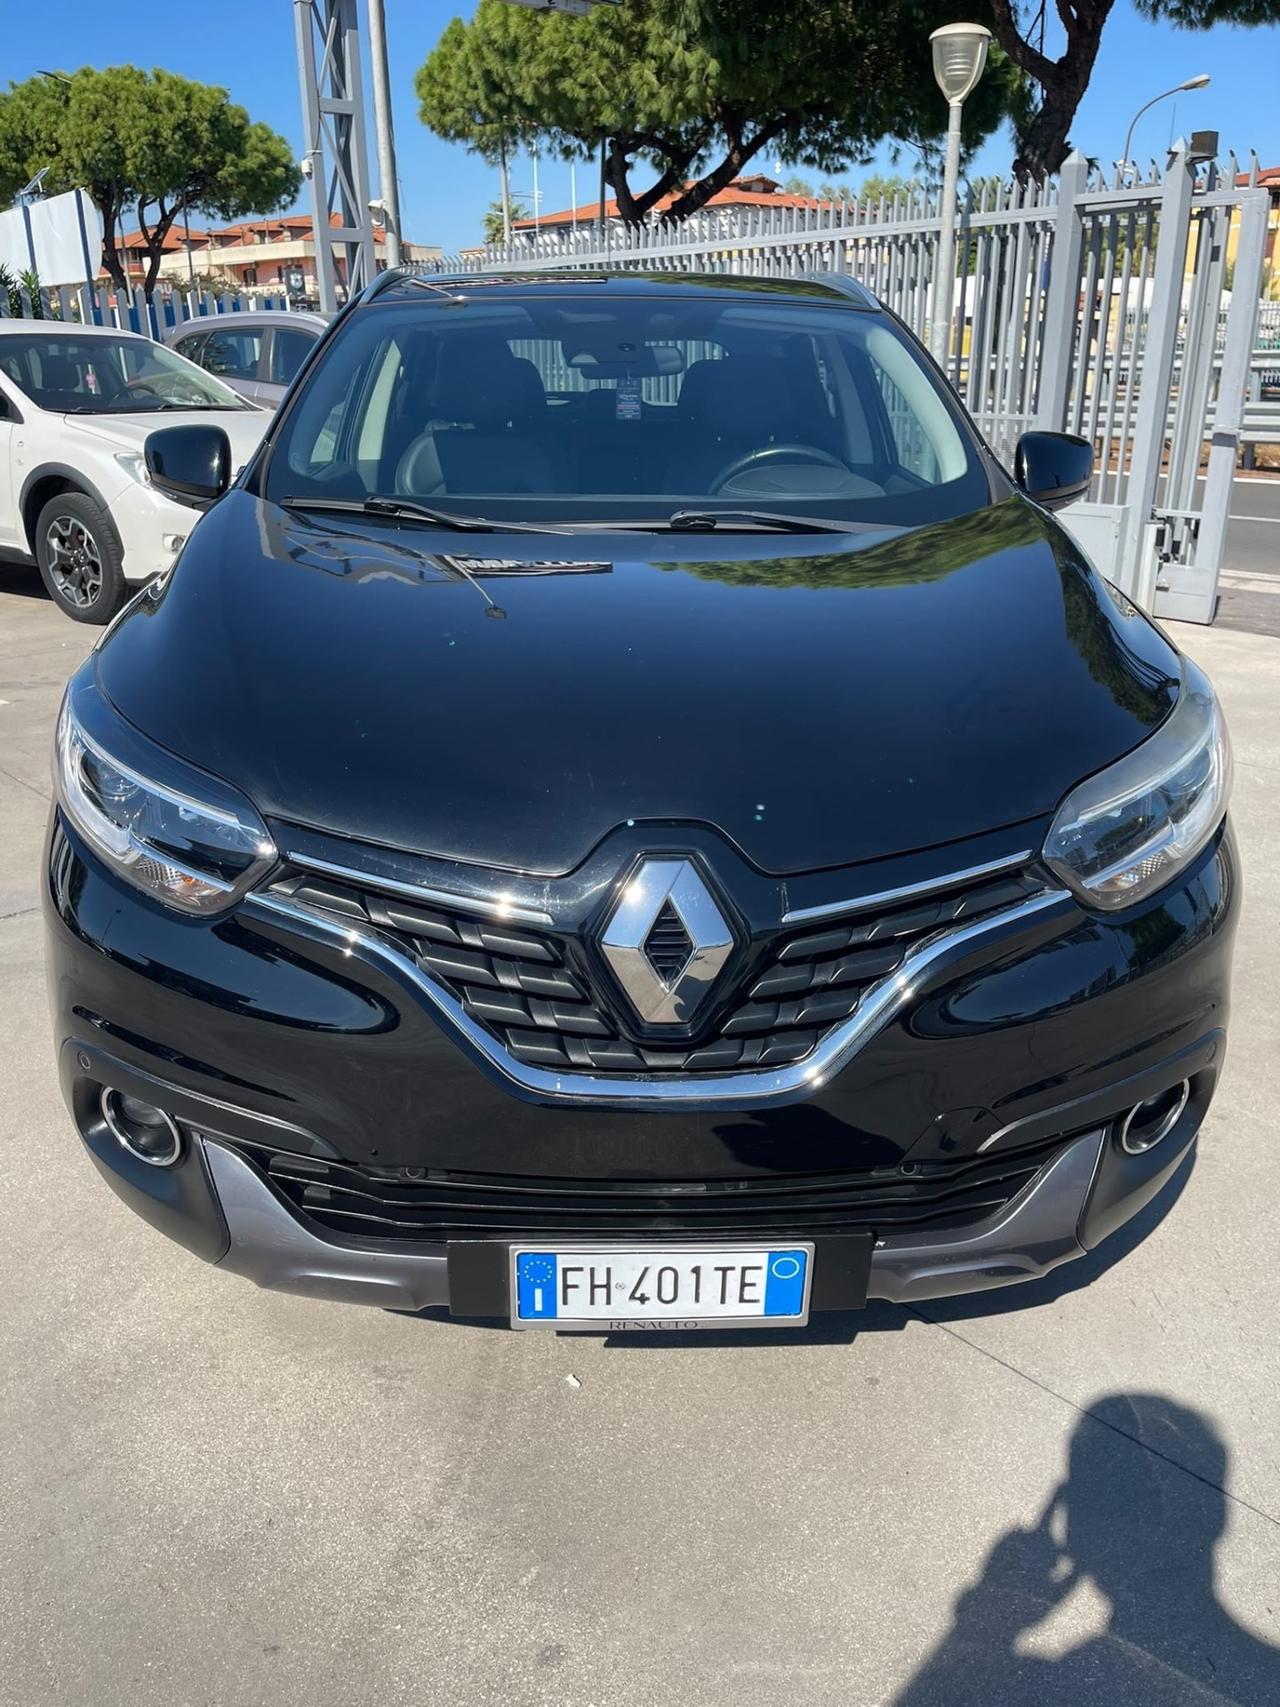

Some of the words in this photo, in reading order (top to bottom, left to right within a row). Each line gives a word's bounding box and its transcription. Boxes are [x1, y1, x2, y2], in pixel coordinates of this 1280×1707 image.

[561, 1266, 611, 1306] FH
[534, 1288, 543, 1312] I
[609, 1320, 698, 1330] RENAUTO
